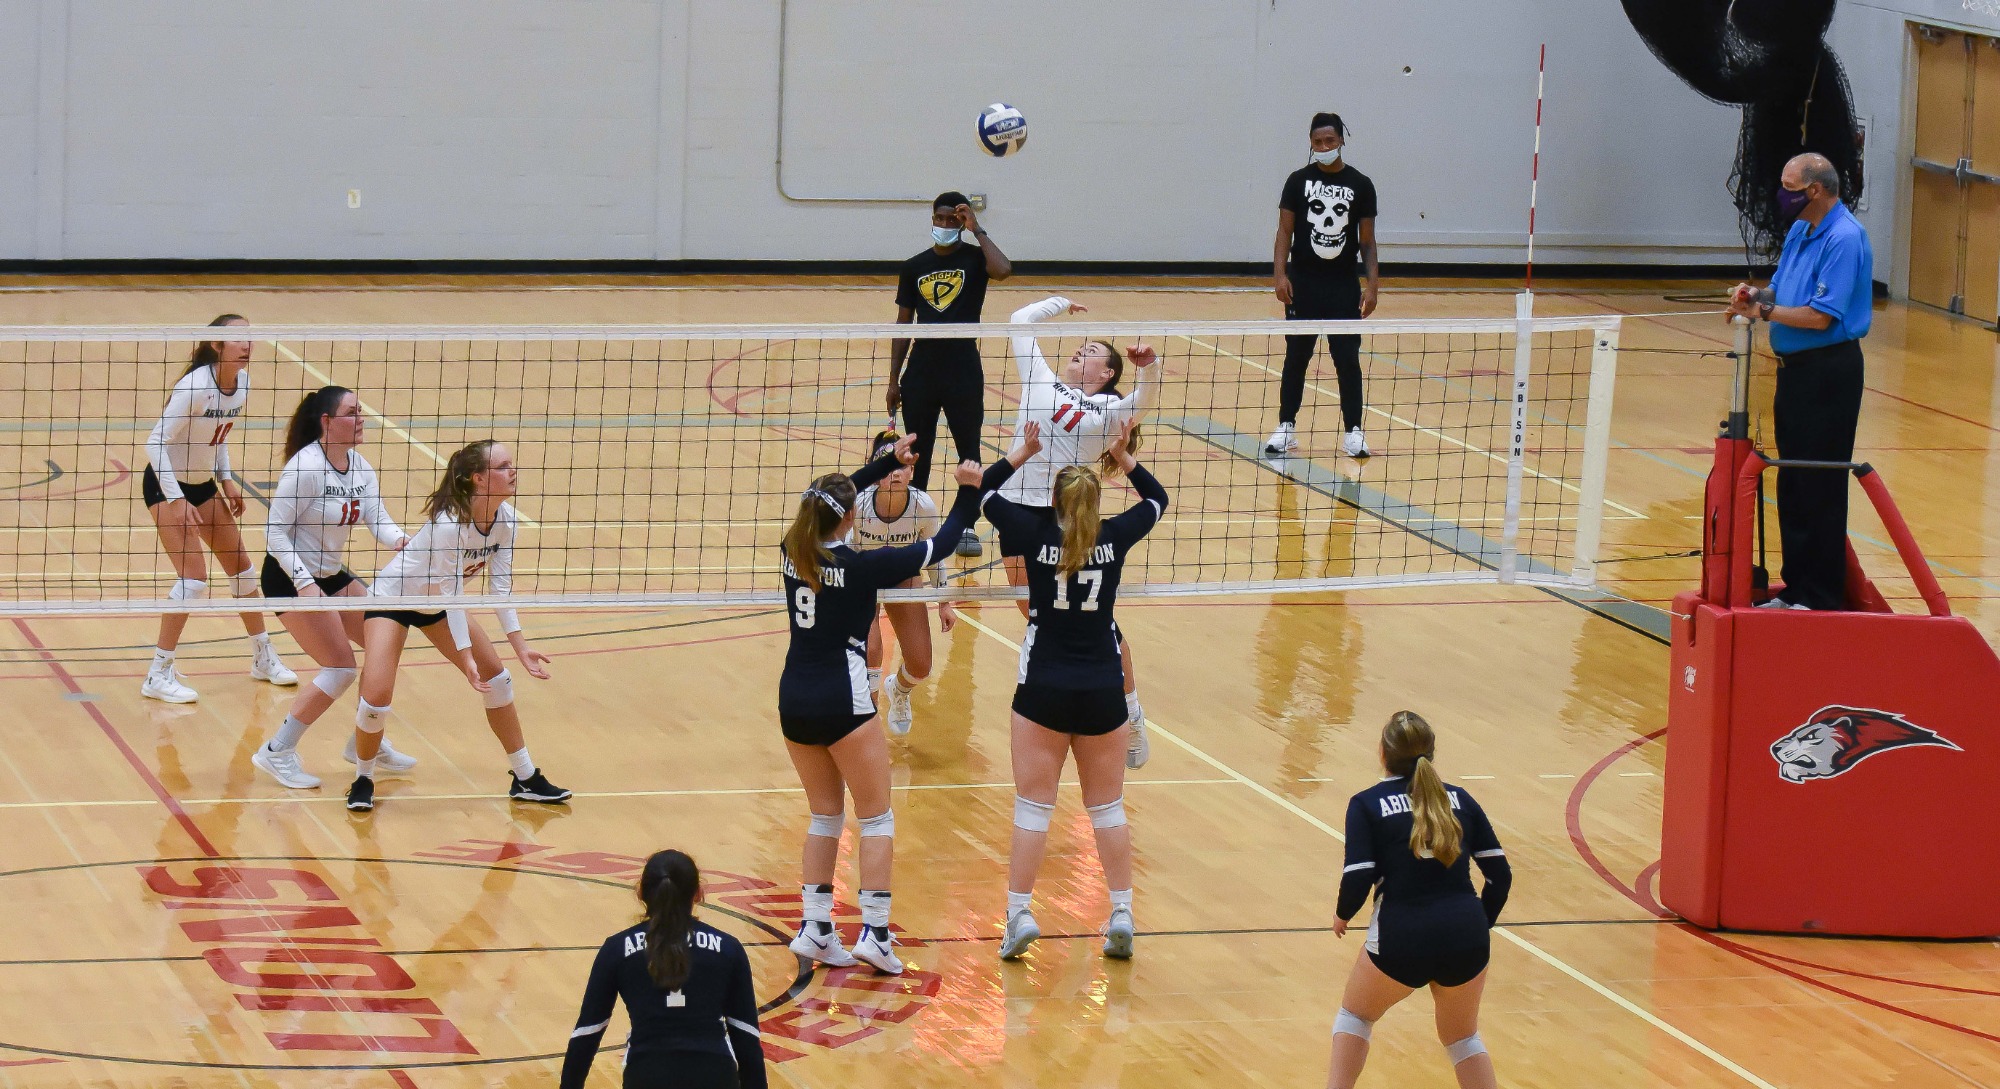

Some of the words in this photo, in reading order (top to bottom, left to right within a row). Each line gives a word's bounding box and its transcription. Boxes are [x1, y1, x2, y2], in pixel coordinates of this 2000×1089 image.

[920, 271, 962, 284] KNIGHTS
[933, 281, 956, 306] P
[1051, 404, 1086, 433] 11
[1513, 393, 1525, 457] BISON
[209, 422, 234, 446] 10
[1036, 543, 1115, 566] ABTON
[1053, 569, 1102, 611] 17
[795, 586, 816, 629] 9
[135, 865, 481, 1056] LIONS
